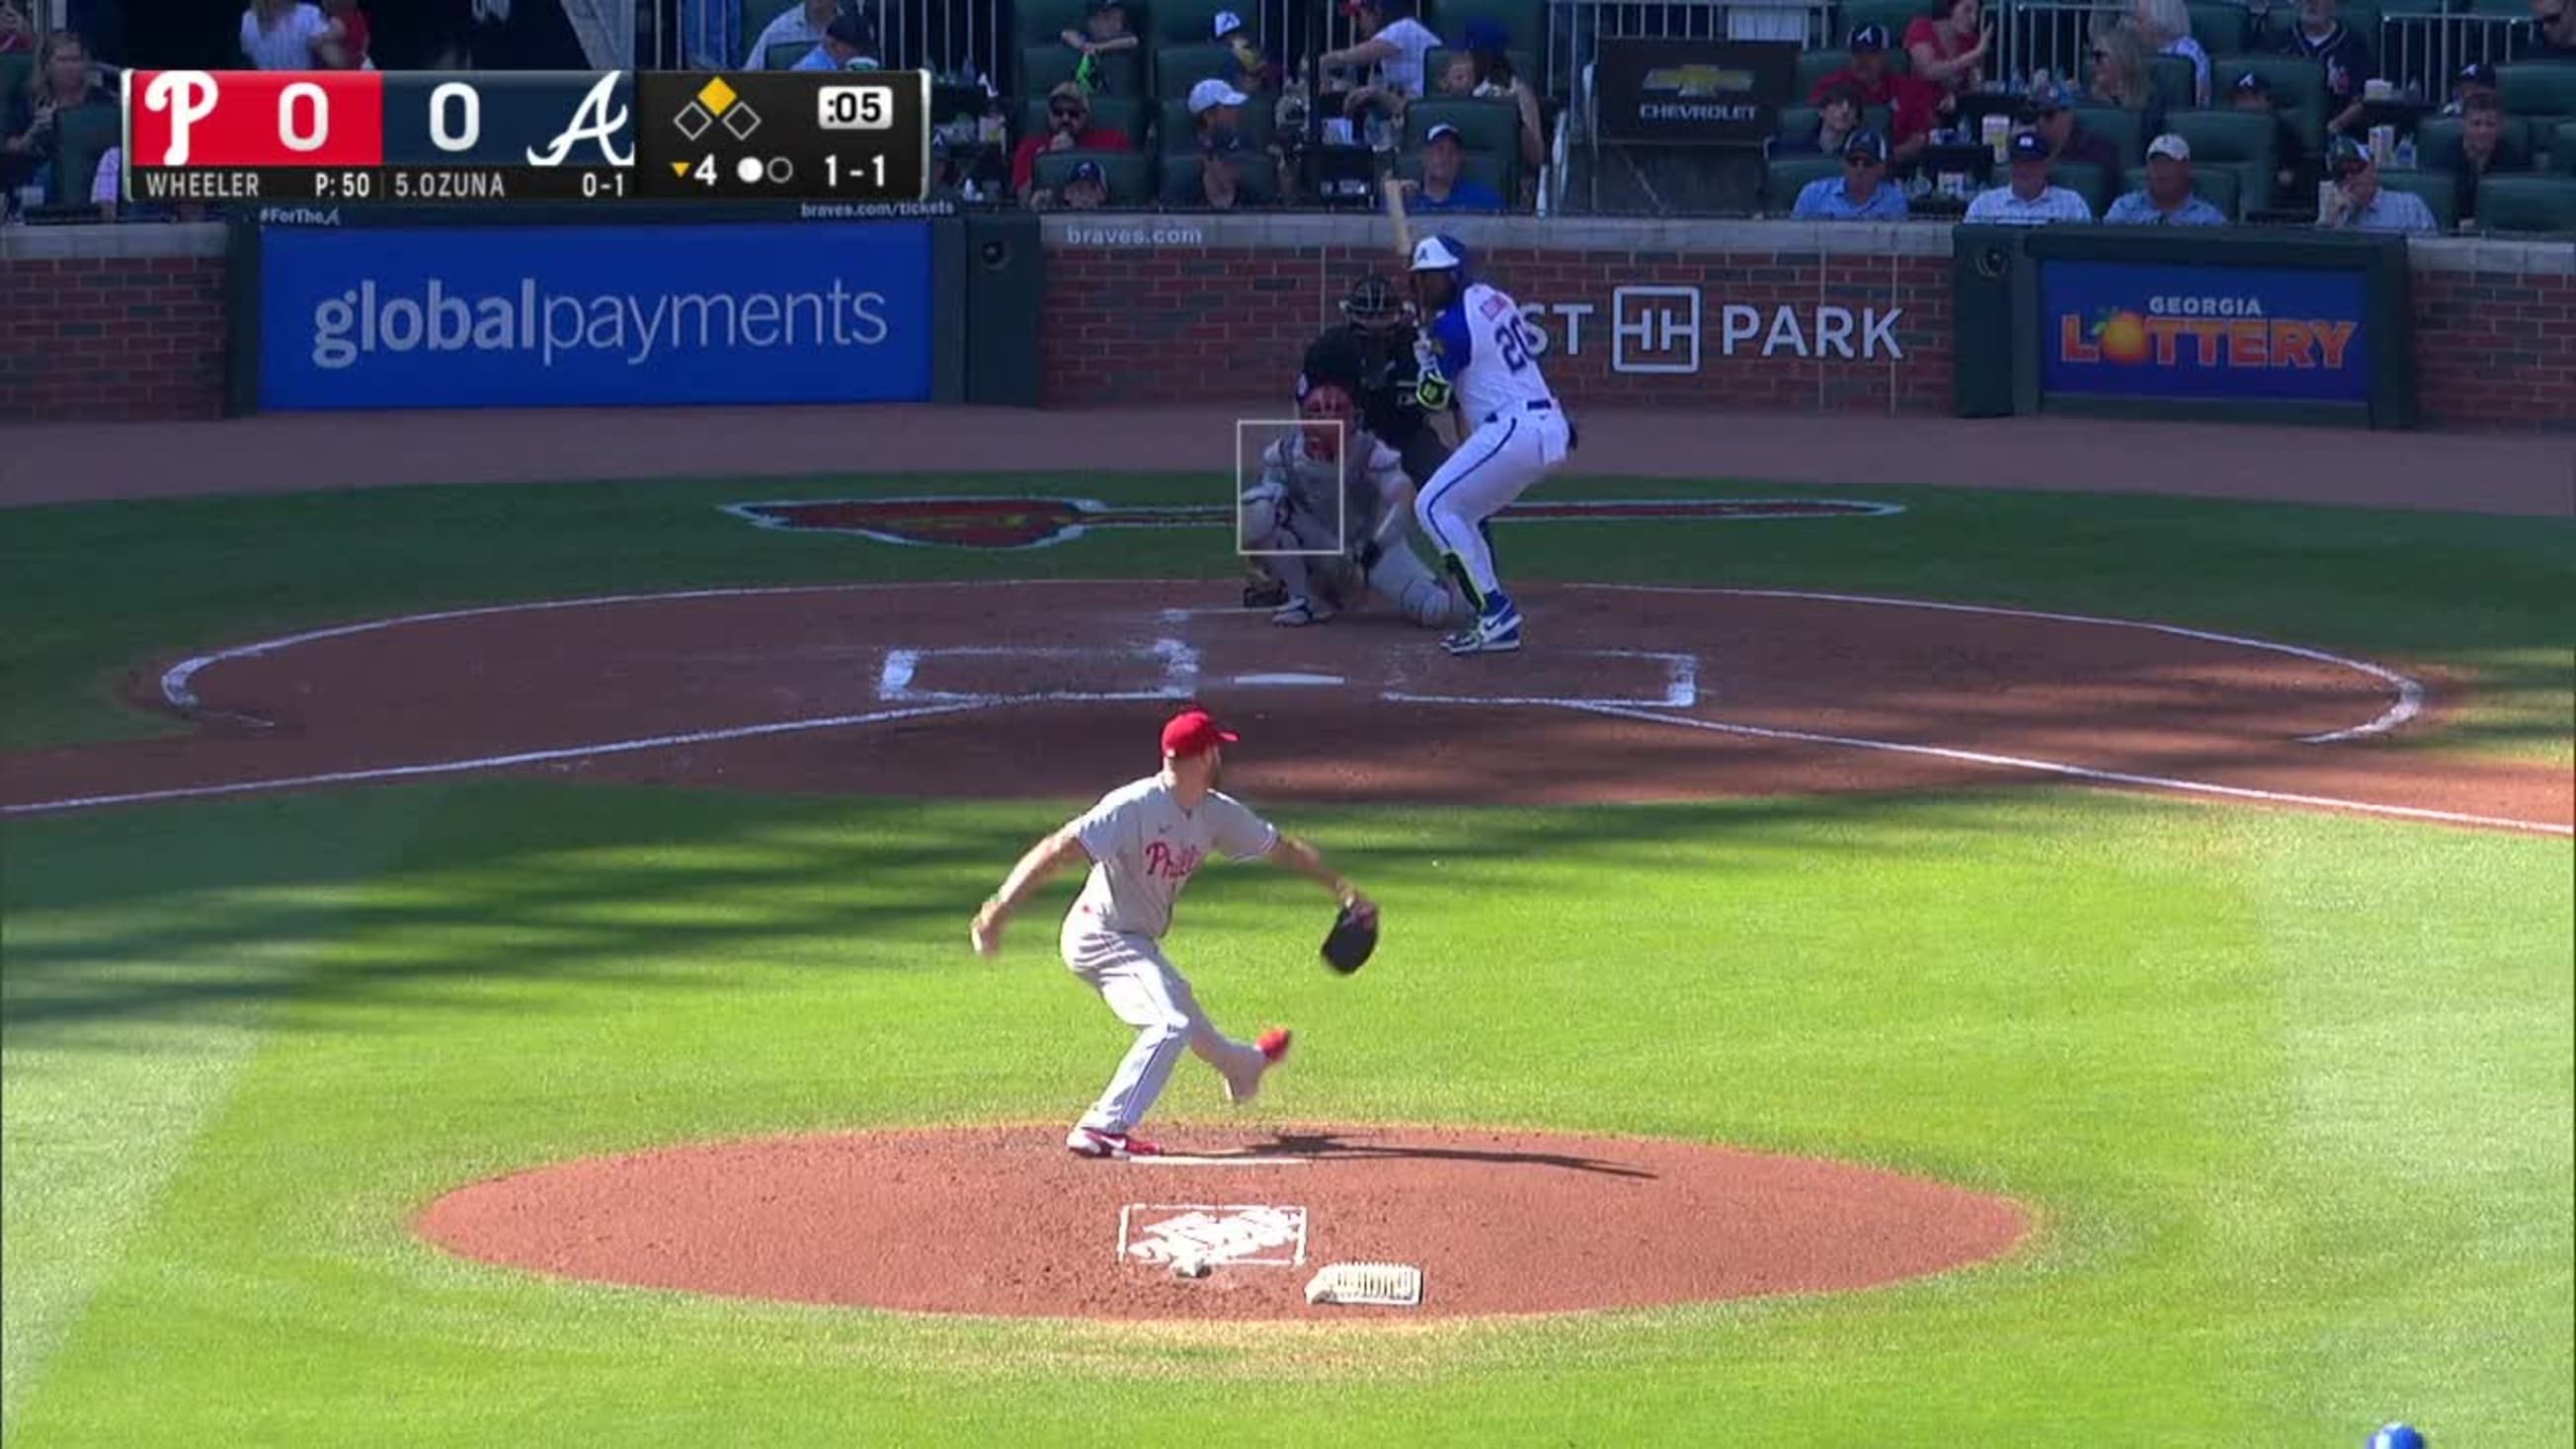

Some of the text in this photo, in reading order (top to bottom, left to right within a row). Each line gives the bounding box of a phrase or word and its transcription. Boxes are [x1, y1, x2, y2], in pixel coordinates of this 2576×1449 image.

[1641, 104, 1756, 121] CHEVROLET
[801, 200, 954, 218] braves.com/tickets
[1067, 224, 1202, 245] braves.com
[2149, 296, 2262, 315] GEORGIA
[312, 278, 888, 368] globalpayments
[1521, 303, 1593, 356] ST
[1724, 304, 1903, 359] PARK
[2061, 313, 2358, 368] LOTTERY
